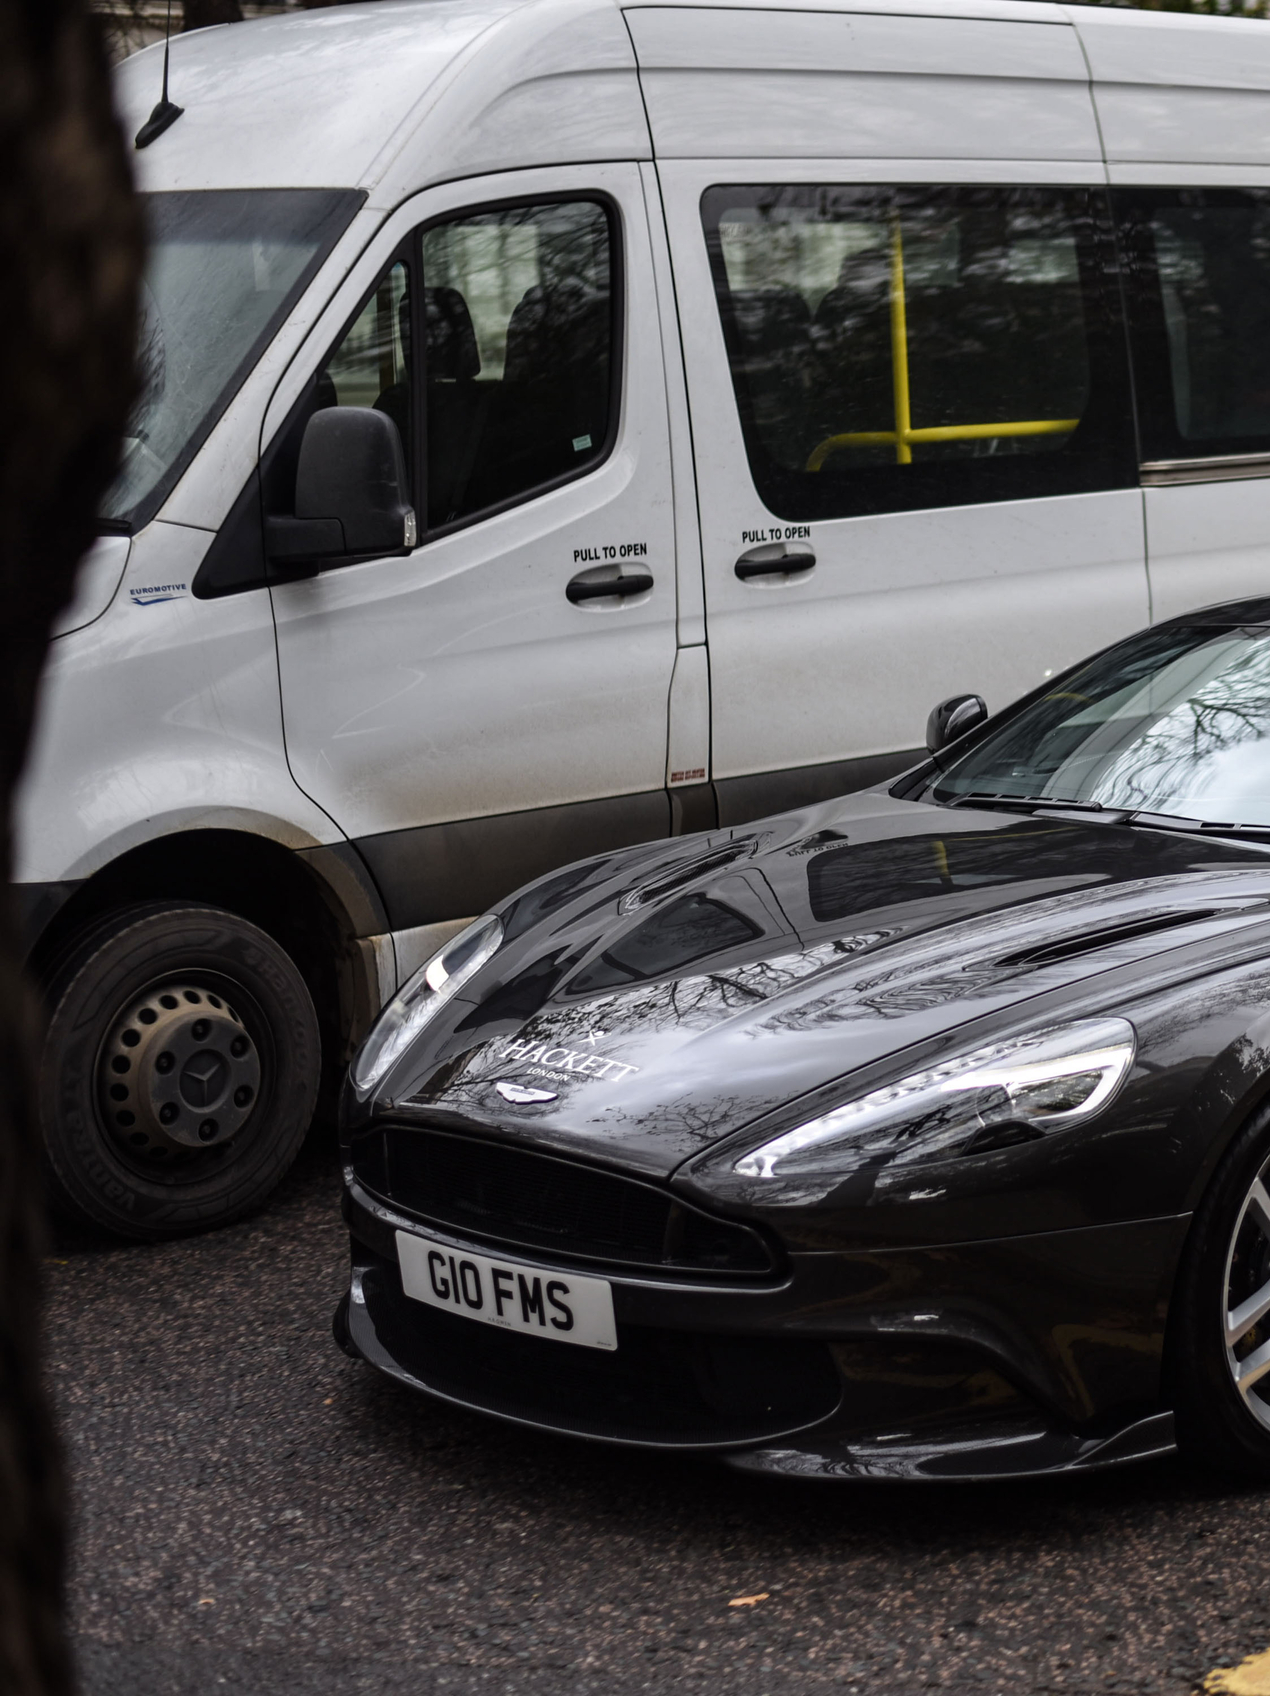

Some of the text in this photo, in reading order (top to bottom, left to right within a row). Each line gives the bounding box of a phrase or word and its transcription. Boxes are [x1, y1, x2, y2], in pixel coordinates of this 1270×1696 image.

[742, 526, 811, 543] PULL TO OPEN
[573, 543, 647, 562] PULL TO OPEN
[129, 583, 187, 596] EUROMOTIVE
[499, 1039, 640, 1083] HACKETT
[526, 1066, 571, 1082] LONDON
[491, 1267, 574, 1331] FMS
